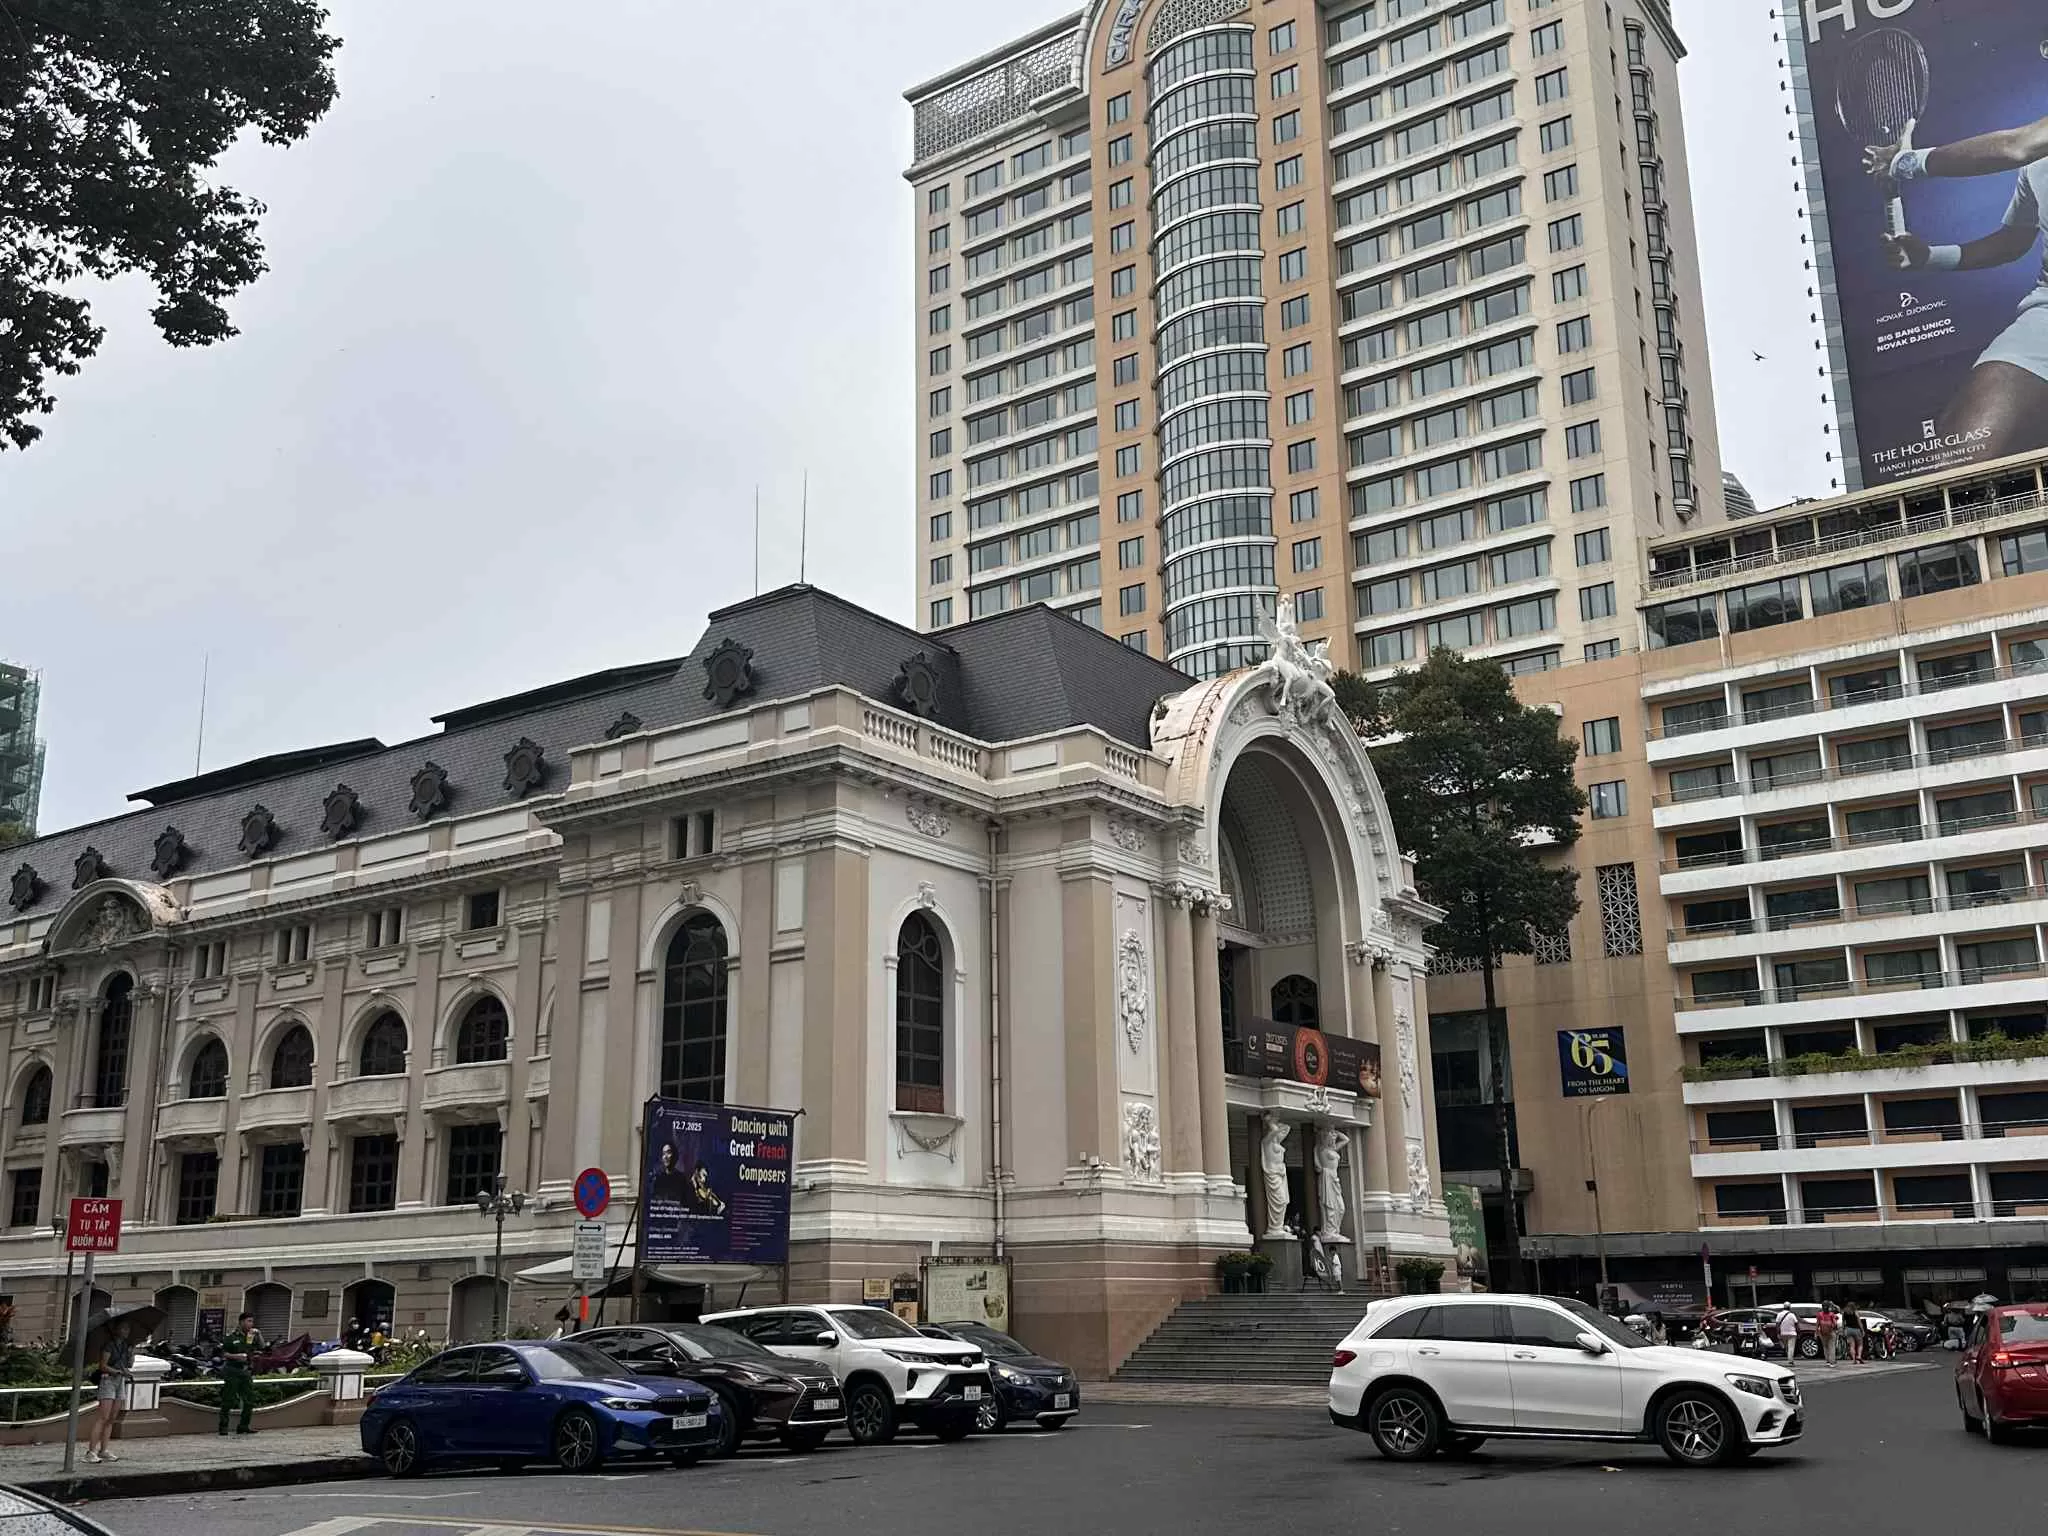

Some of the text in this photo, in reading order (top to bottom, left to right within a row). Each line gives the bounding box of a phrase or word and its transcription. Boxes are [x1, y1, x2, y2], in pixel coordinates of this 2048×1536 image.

[1876, 300, 1947, 324] NOVAK DJOKOVIC
[1876, 326, 1956, 352] NOVAK DJOKOVIC
[1878, 318, 1951, 343] BIG BANG UNICO
[1872, 426, 1992, 463] THE HOUR GLASS
[1880, 462, 1906, 473] HANOI
[1912, 458, 1925, 466] HO
[1942, 448, 1966, 459] MINH
[1967, 443, 1986, 453] CITY
[1571, 1032, 1613, 1075] 65
[672, 1120, 702, 1132] 12.7.2025
[731, 1116, 788, 1140] Dancing with
[729, 1139, 786, 1160] Great French
[739, 1164, 786, 1186] Composers
